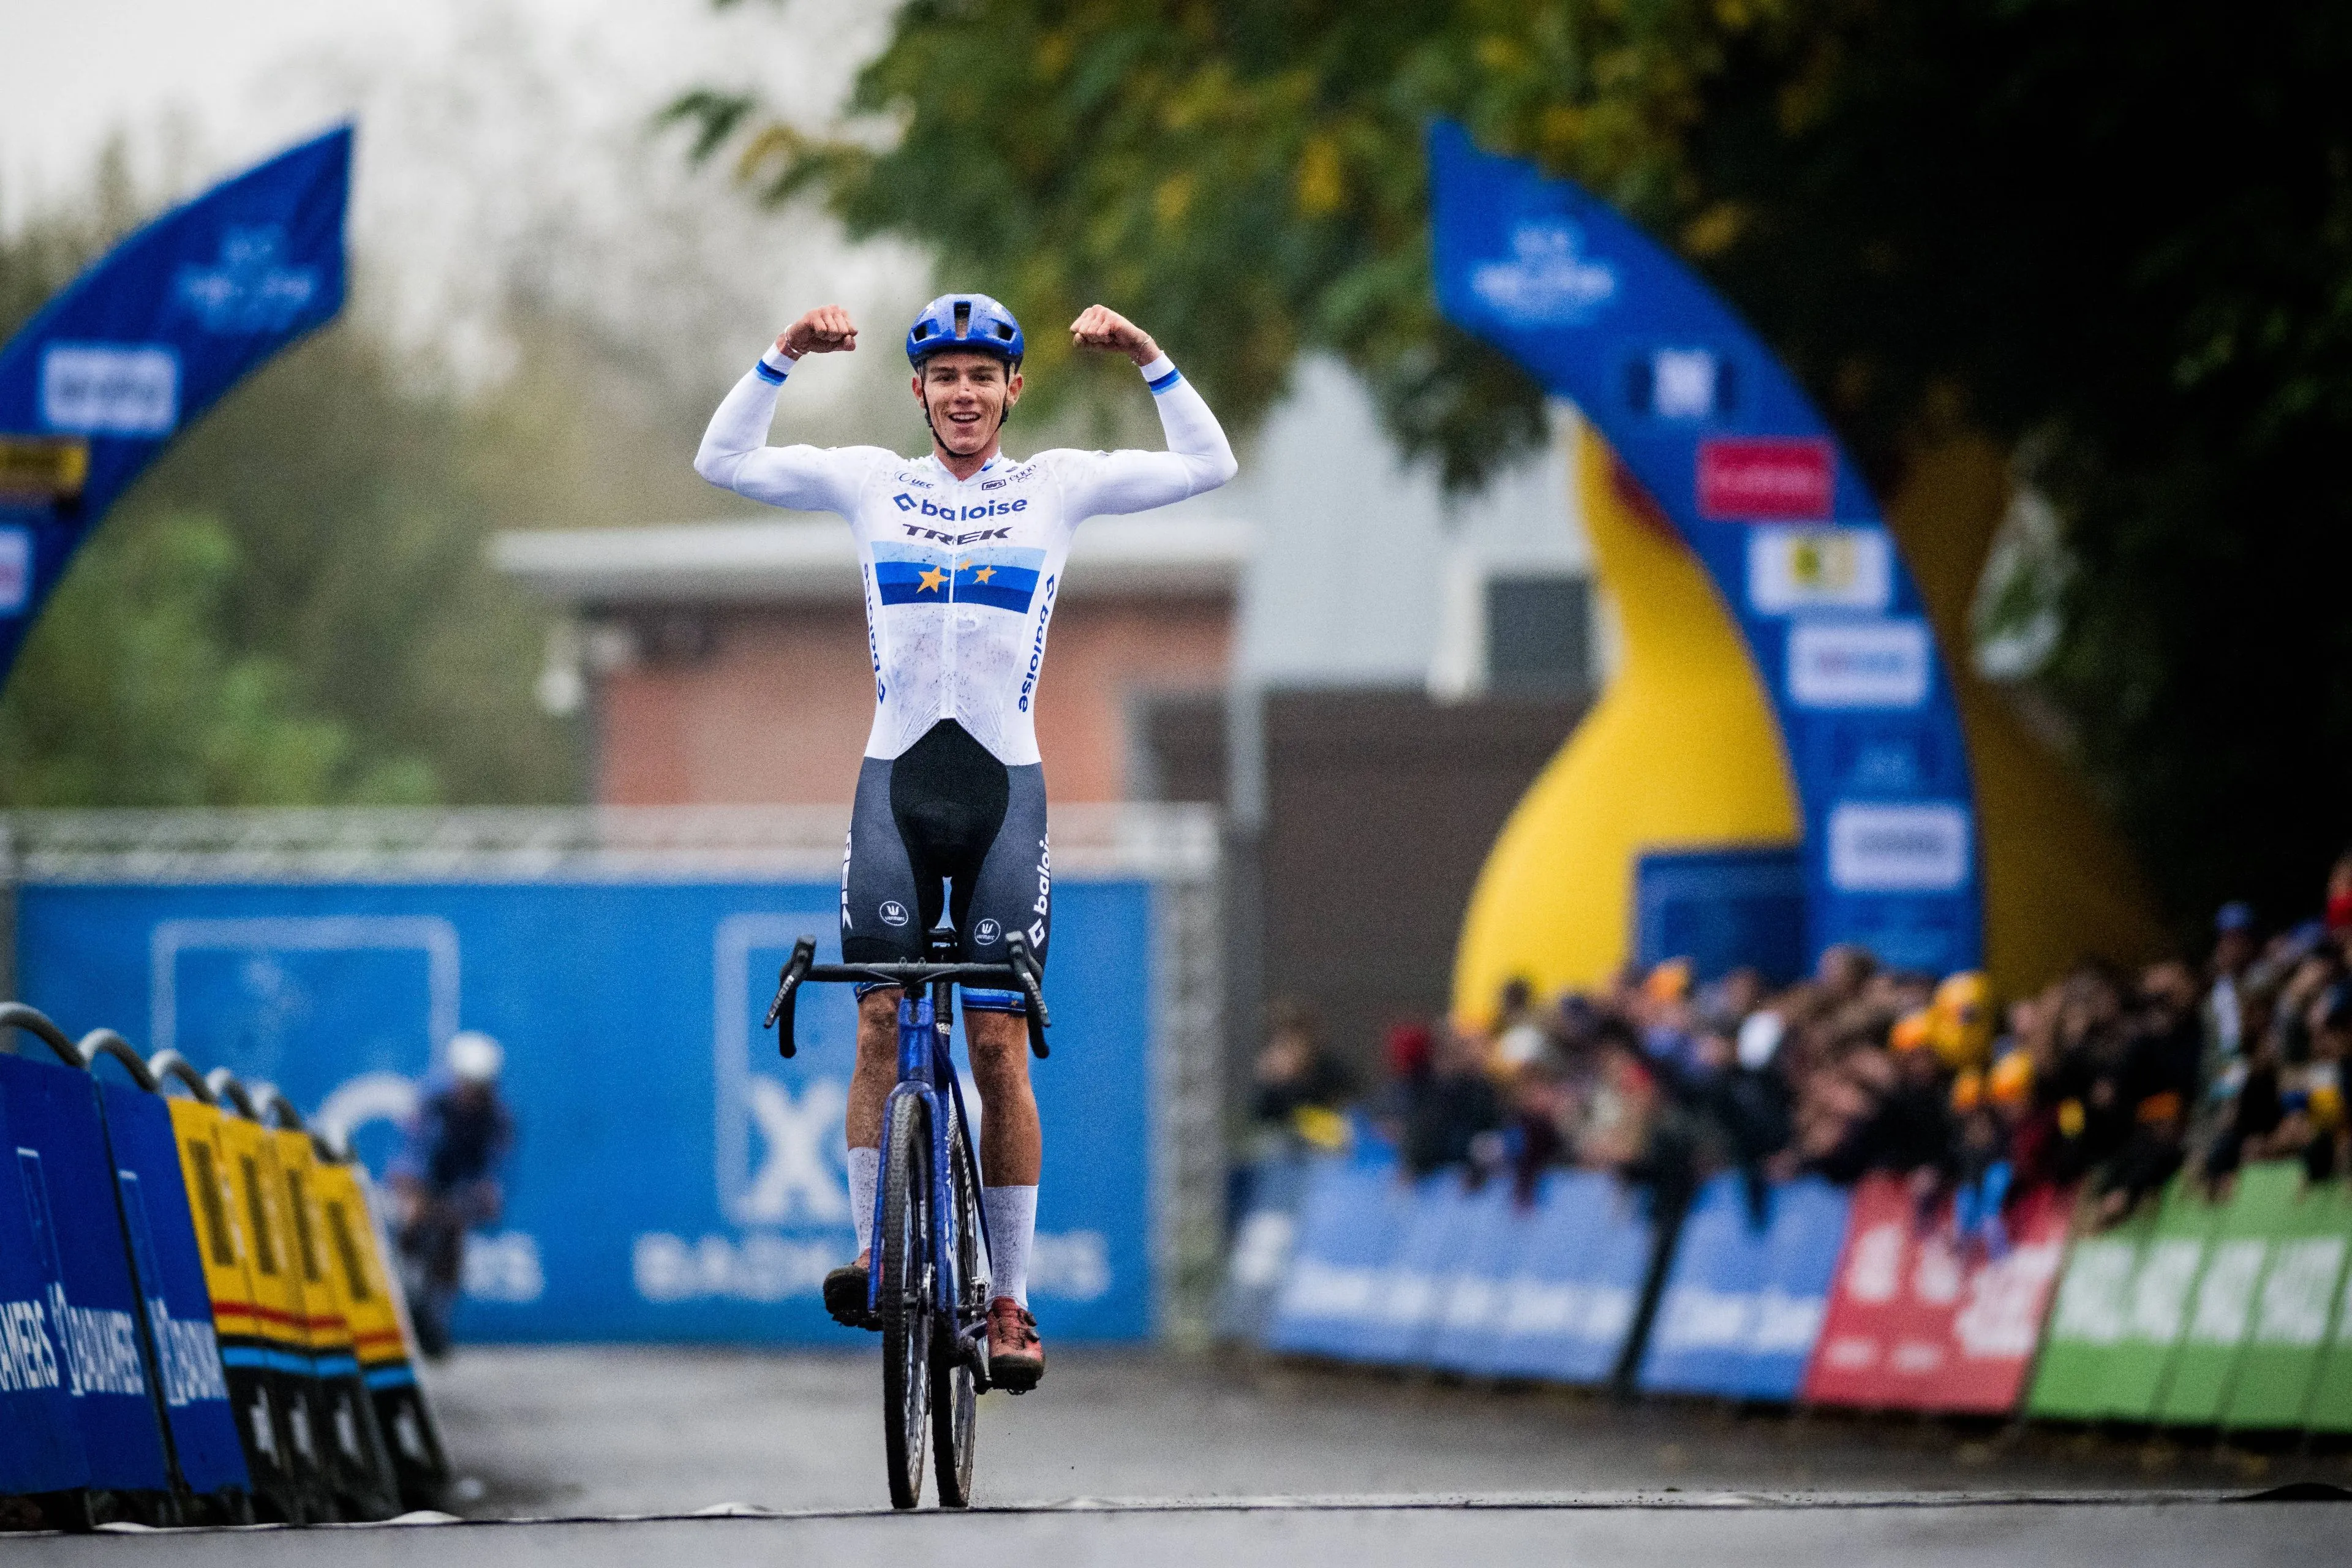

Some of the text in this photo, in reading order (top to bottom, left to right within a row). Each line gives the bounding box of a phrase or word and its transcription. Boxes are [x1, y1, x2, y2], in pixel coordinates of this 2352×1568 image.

[921, 499, 1028, 521] baloise
[903, 524, 1013, 546] TREK
[1019, 603, 1049, 712] baloise
